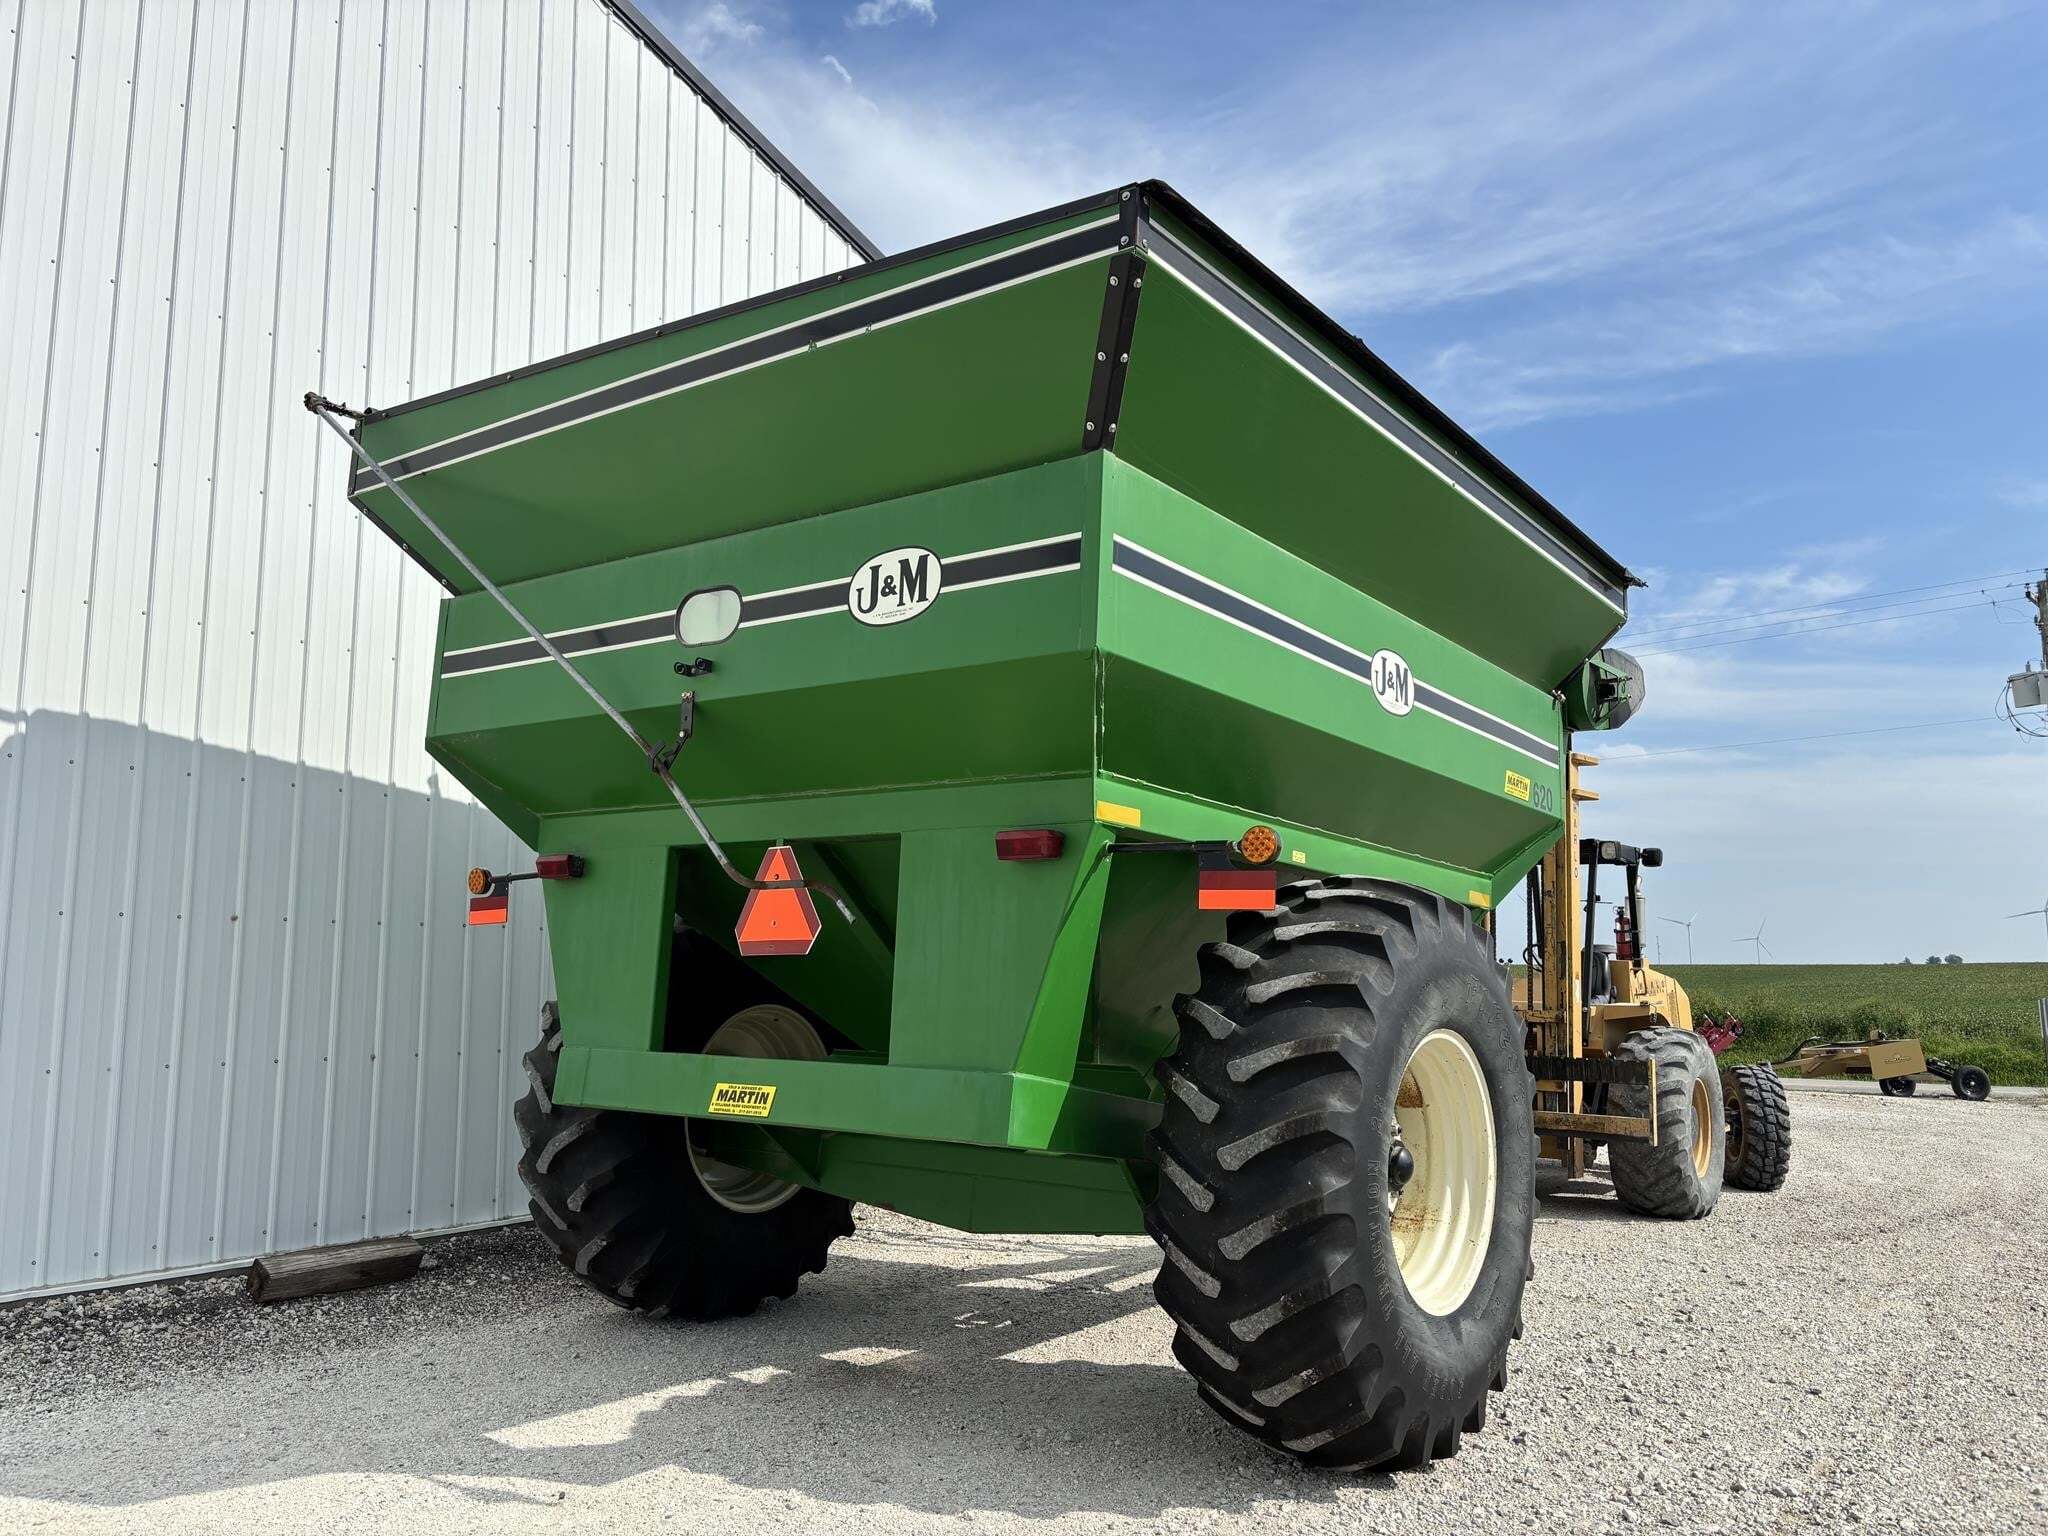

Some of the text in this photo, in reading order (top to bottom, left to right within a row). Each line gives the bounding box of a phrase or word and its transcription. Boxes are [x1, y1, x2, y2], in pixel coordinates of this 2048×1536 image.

[856, 553, 930, 614] J&M
[1375, 656, 1409, 706] J&M
[1507, 775, 1529, 792] MARTIN
[1533, 782, 1553, 812] 620
[717, 1089, 770, 1105] MARTIN
